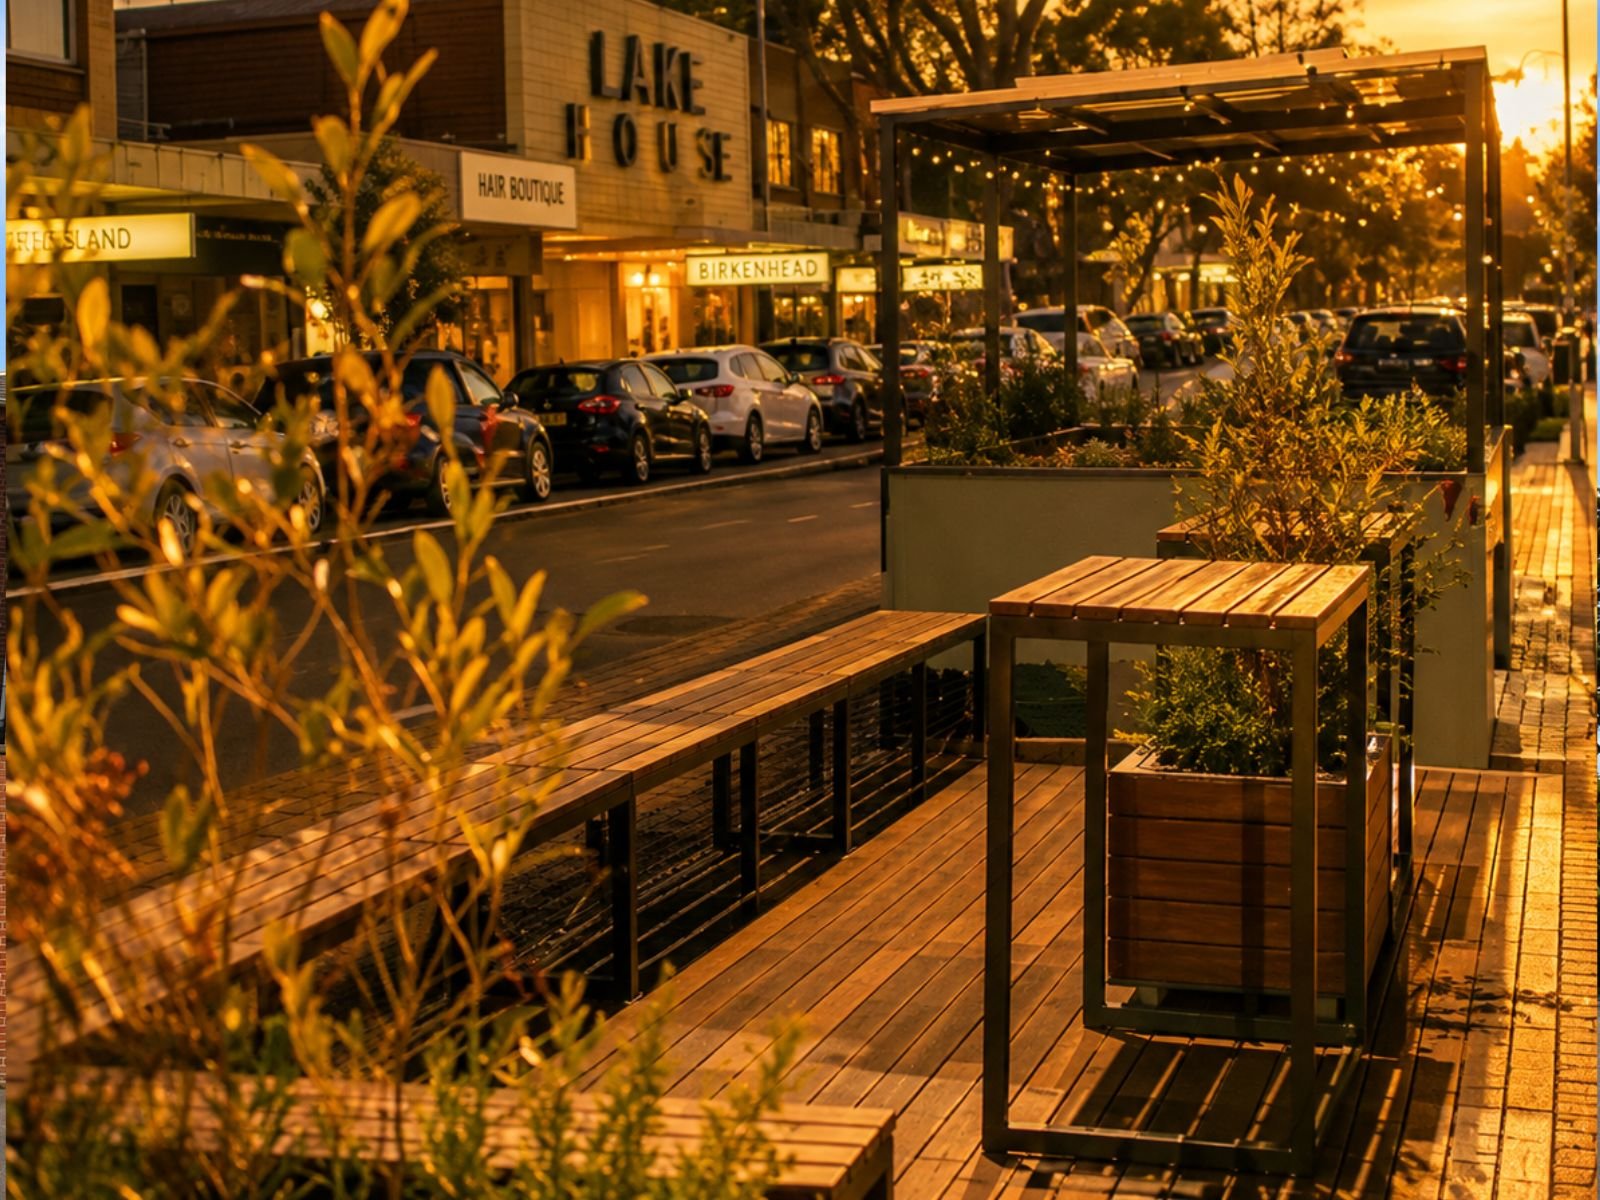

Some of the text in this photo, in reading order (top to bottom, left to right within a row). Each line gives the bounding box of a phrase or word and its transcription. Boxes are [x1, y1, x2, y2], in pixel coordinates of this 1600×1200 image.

[589, 30, 705, 115] LAKE
[566, 103, 733, 182] HOUSE
[478, 172, 565, 207] HAIR BOUTIQUE
[60, 227, 132, 250] SLAND
[699, 258, 818, 280] BIRKENHEAD
